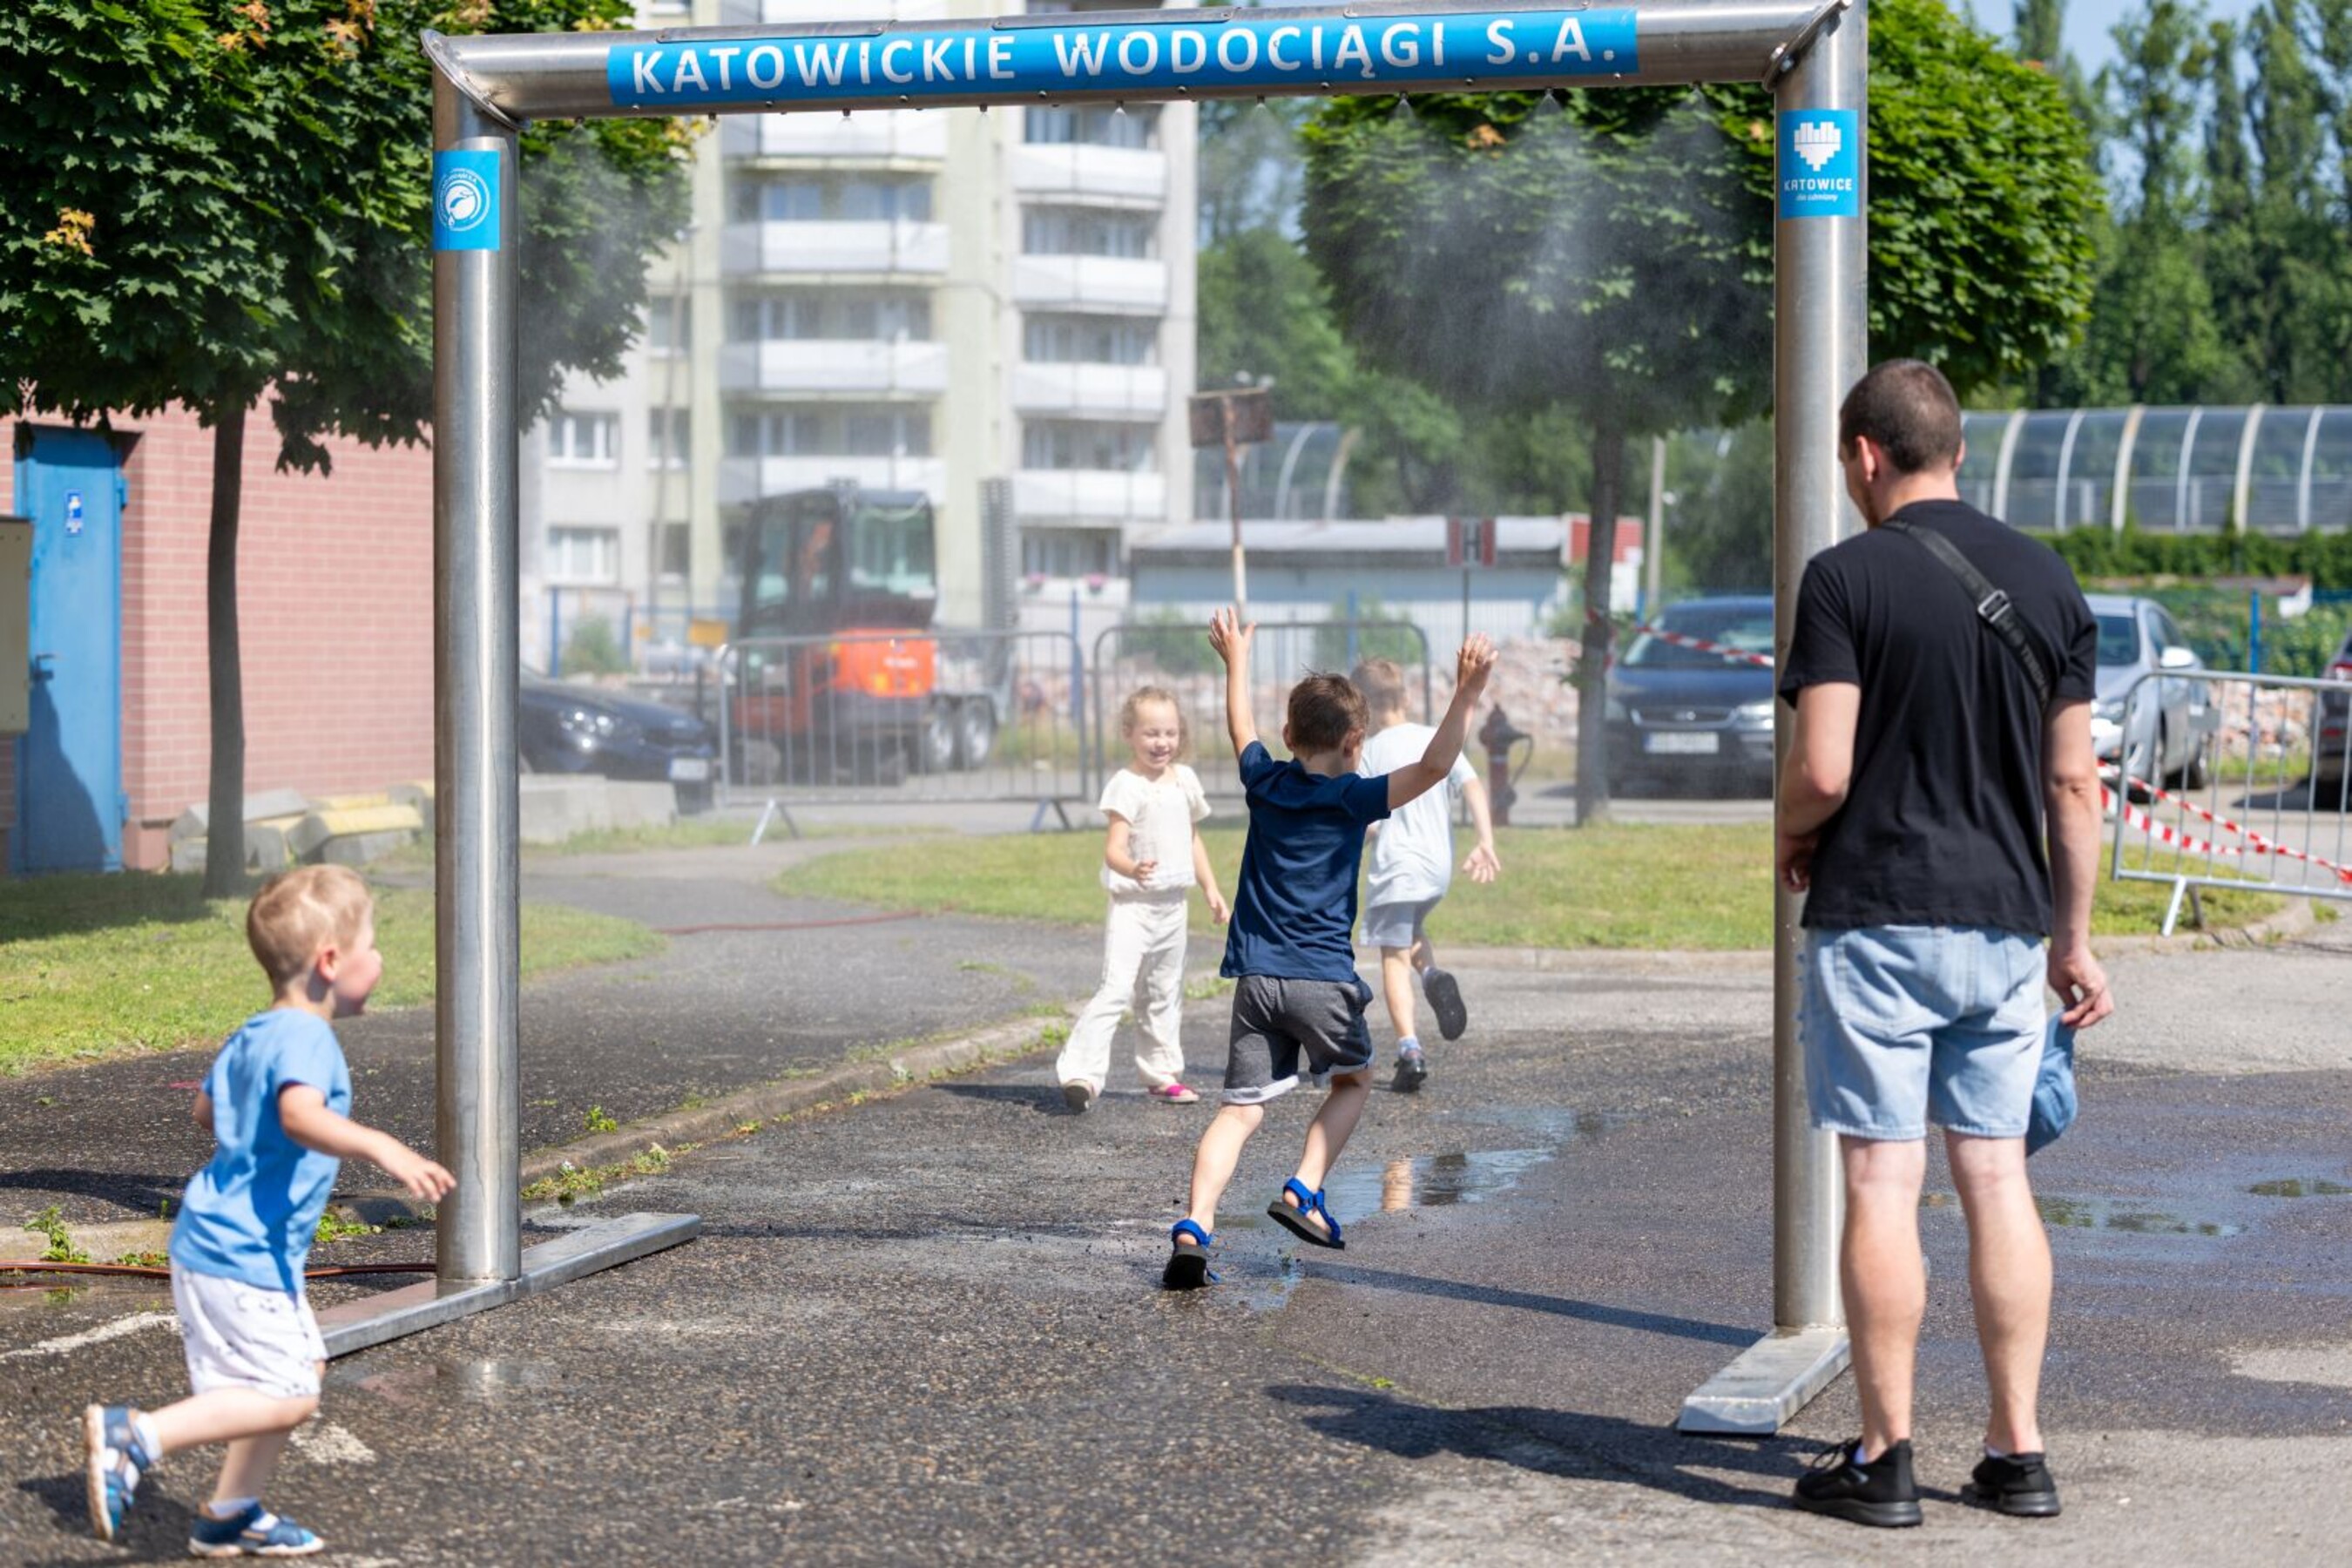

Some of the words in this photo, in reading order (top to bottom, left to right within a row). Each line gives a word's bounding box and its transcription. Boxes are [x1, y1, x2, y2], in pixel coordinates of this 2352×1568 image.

[632, 35, 1017, 94] KATOWICKIE
[1052, 22, 1445, 78] WODOCIĄGI
[1486, 17, 1615, 64] S.A.
[1783, 178, 1853, 192] KATOWICE
